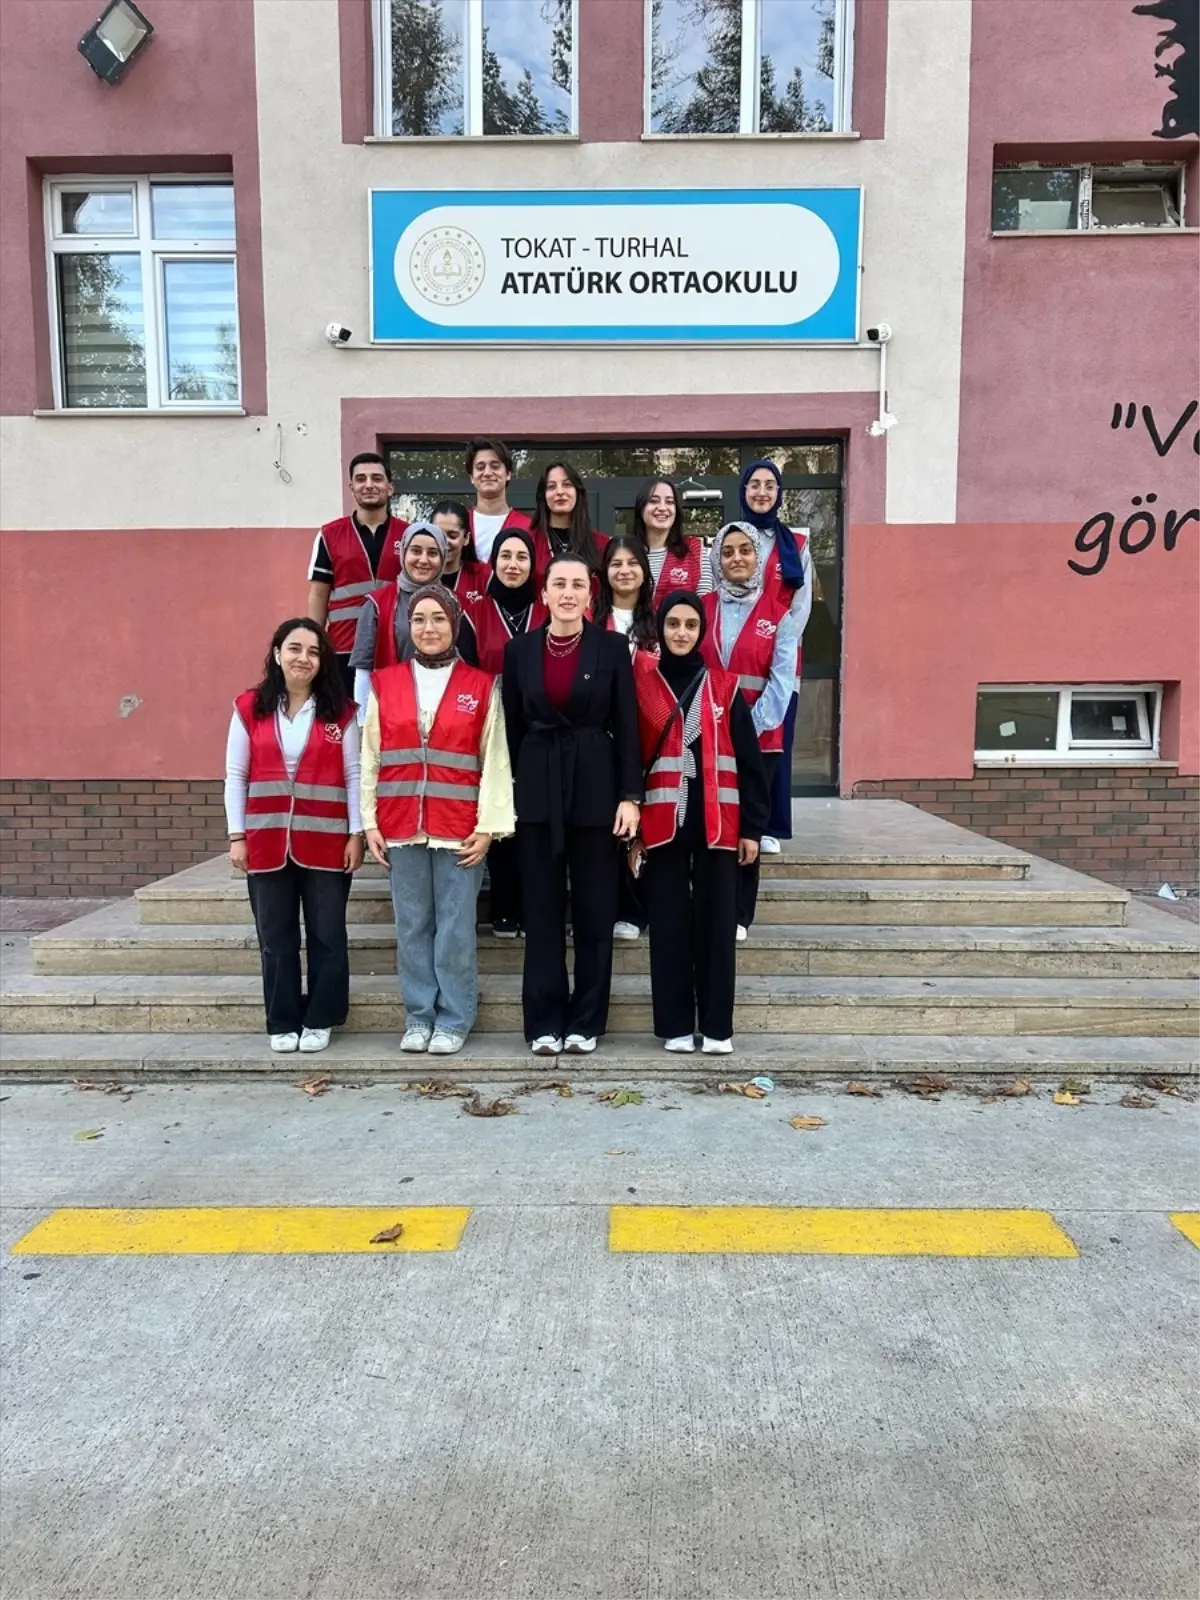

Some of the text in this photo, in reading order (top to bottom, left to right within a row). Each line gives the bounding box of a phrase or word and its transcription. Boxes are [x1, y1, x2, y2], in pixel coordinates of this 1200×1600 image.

[500, 237, 577, 259] TOKAT
[594, 236, 689, 258] TURHAL
[500, 266, 798, 295] ATATÜRK ORTAOKULU
[1110, 400, 1200, 457] "V
